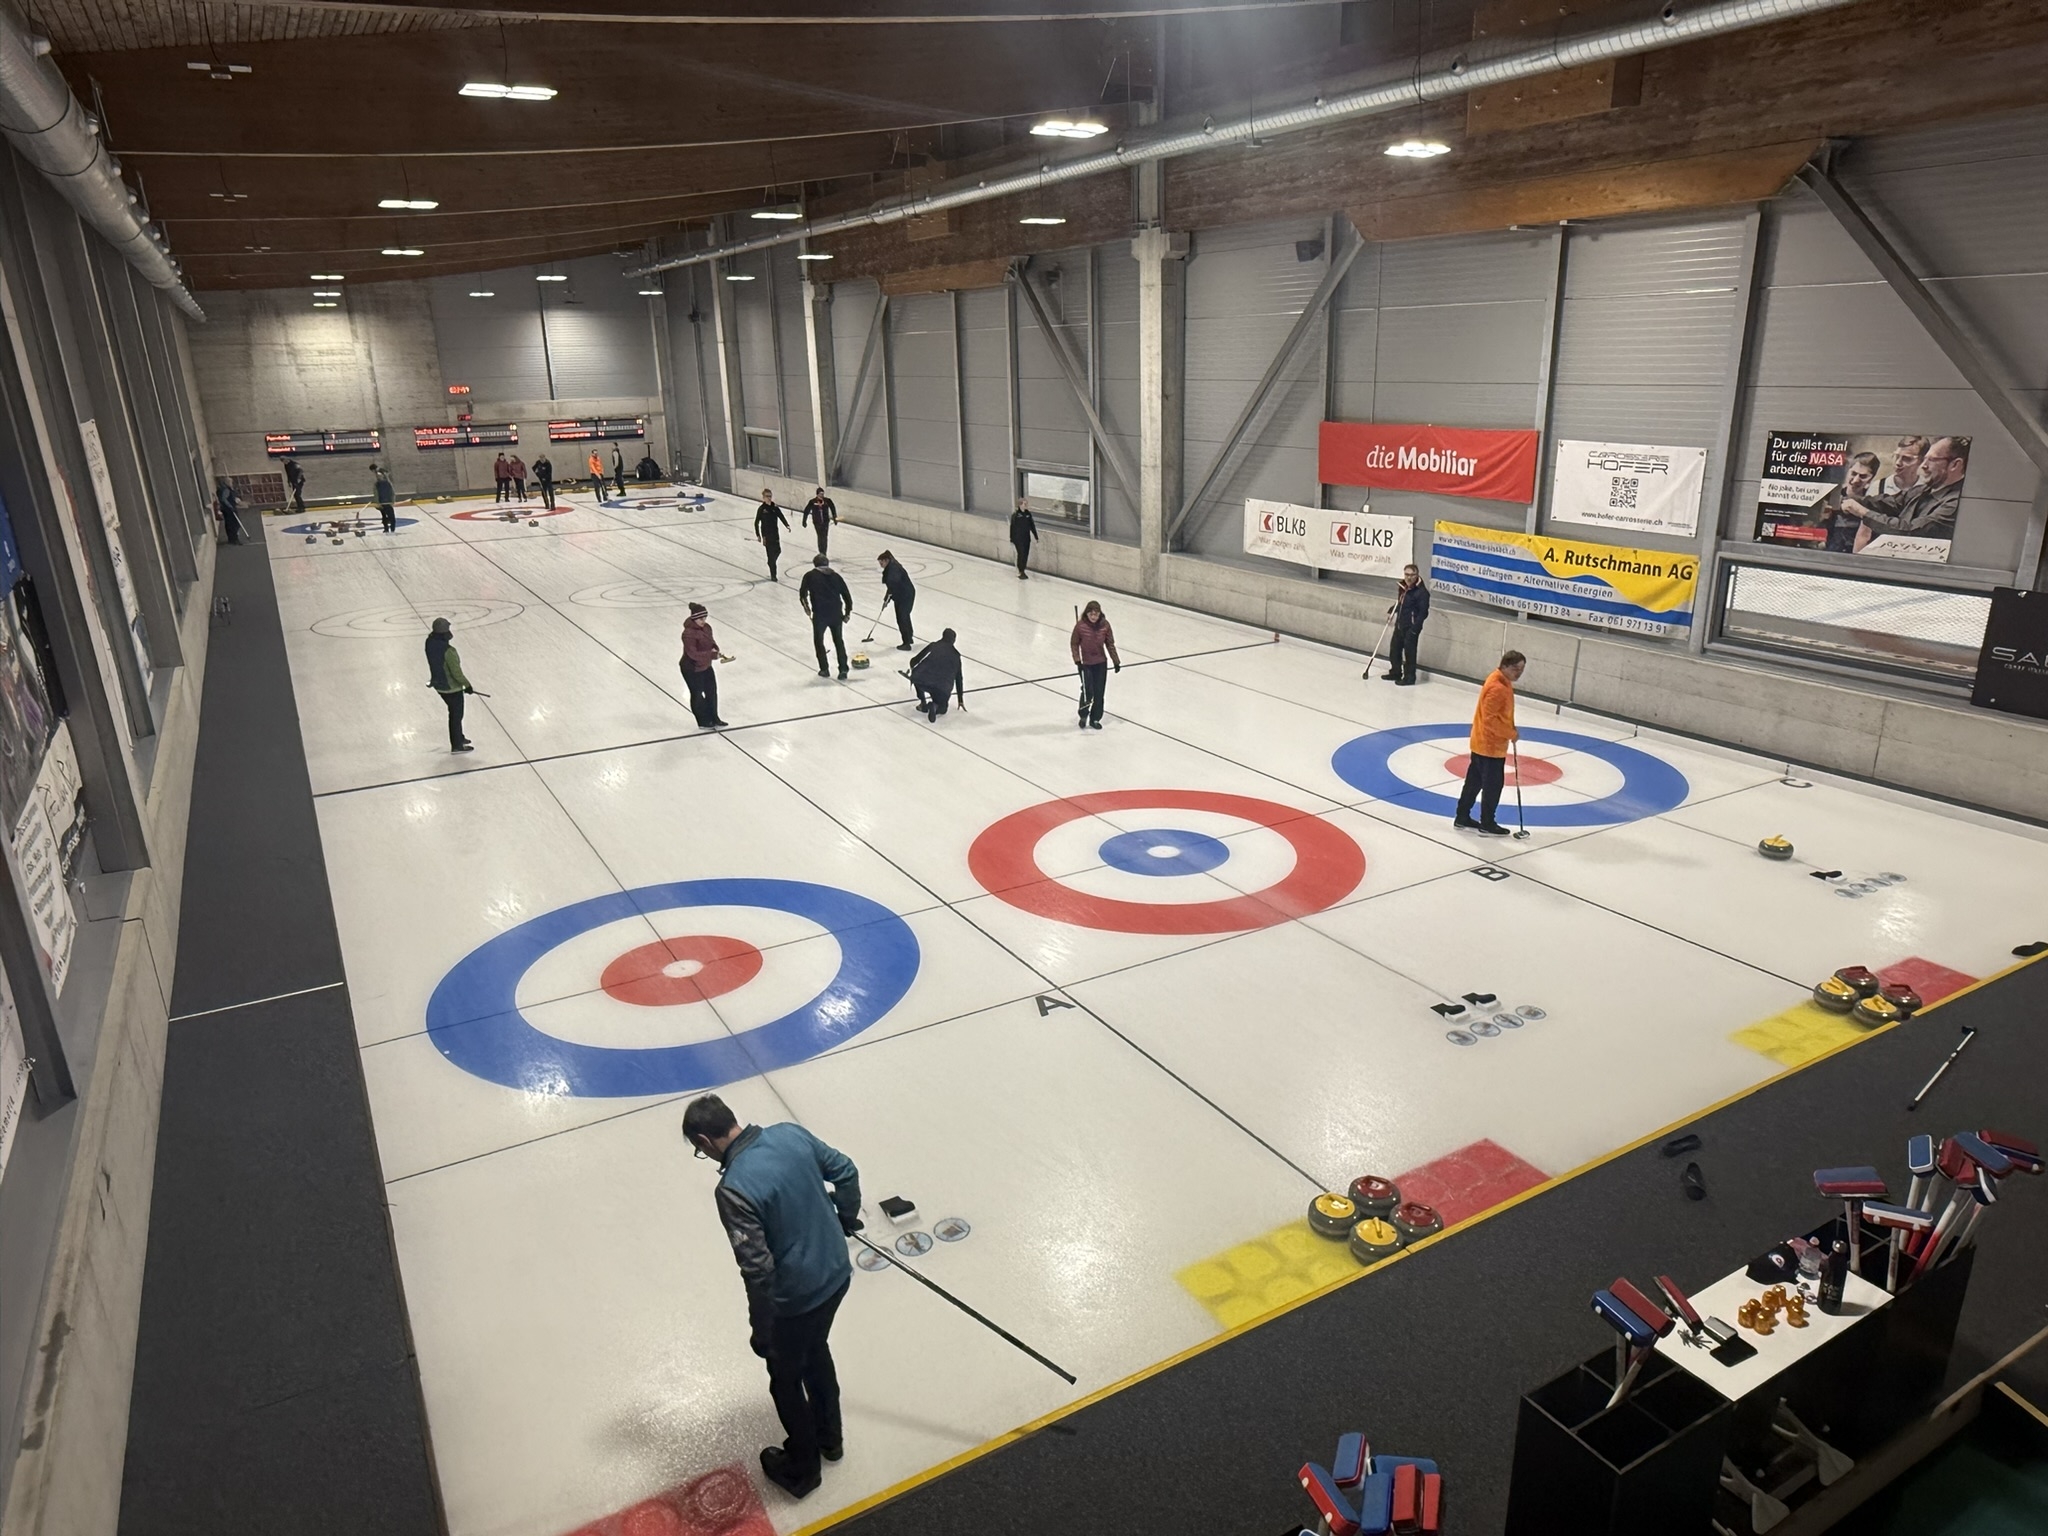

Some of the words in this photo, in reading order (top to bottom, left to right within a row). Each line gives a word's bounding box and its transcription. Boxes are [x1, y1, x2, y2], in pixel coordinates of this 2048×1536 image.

[1773, 438, 1789, 449] Du
[1792, 439, 1822, 450] willst
[1824, 440, 1848, 452] mal
[1366, 445, 1395, 468] die
[1398, 446, 1478, 476] Mobiliar
[1587, 459, 1669, 475] HOFER
[1771, 450, 1787, 461] für
[1789, 451, 1807, 463] die
[1808, 452, 1843, 466] NASA
[1770, 464, 1823, 477] arbeiten?
[1277, 516, 1306, 536] BLKB
[1581, 512, 1663, 526] www.hofer-carrosserie.ch
[1354, 527, 1394, 547] BLKB
[1330, 549, 1345, 559] Was
[1347, 552, 1373, 563] morgen
[1544, 547, 1559, 562] A.
[1564, 550, 1662, 577] Rutschmann
[1667, 563, 1693, 580] AG
[1523, 575, 1570, 591] Alternative
[1572, 584, 1613, 598] Energien
[1488, 594, 1515, 606] Telefon
[1517, 600, 1531, 610] 061
[1533, 603, 1547, 613] 971
[1550, 605, 1559, 615] 13
[1560, 607, 1571, 616] 84
[1588, 613, 1603, 623] Fax
[1607, 616, 1623, 626] 061
[1626, 619, 1641, 630] 971
[1643, 622, 1653, 632] 13
[1655, 624, 1667, 634] 91
[1035, 995, 1076, 1017] A
